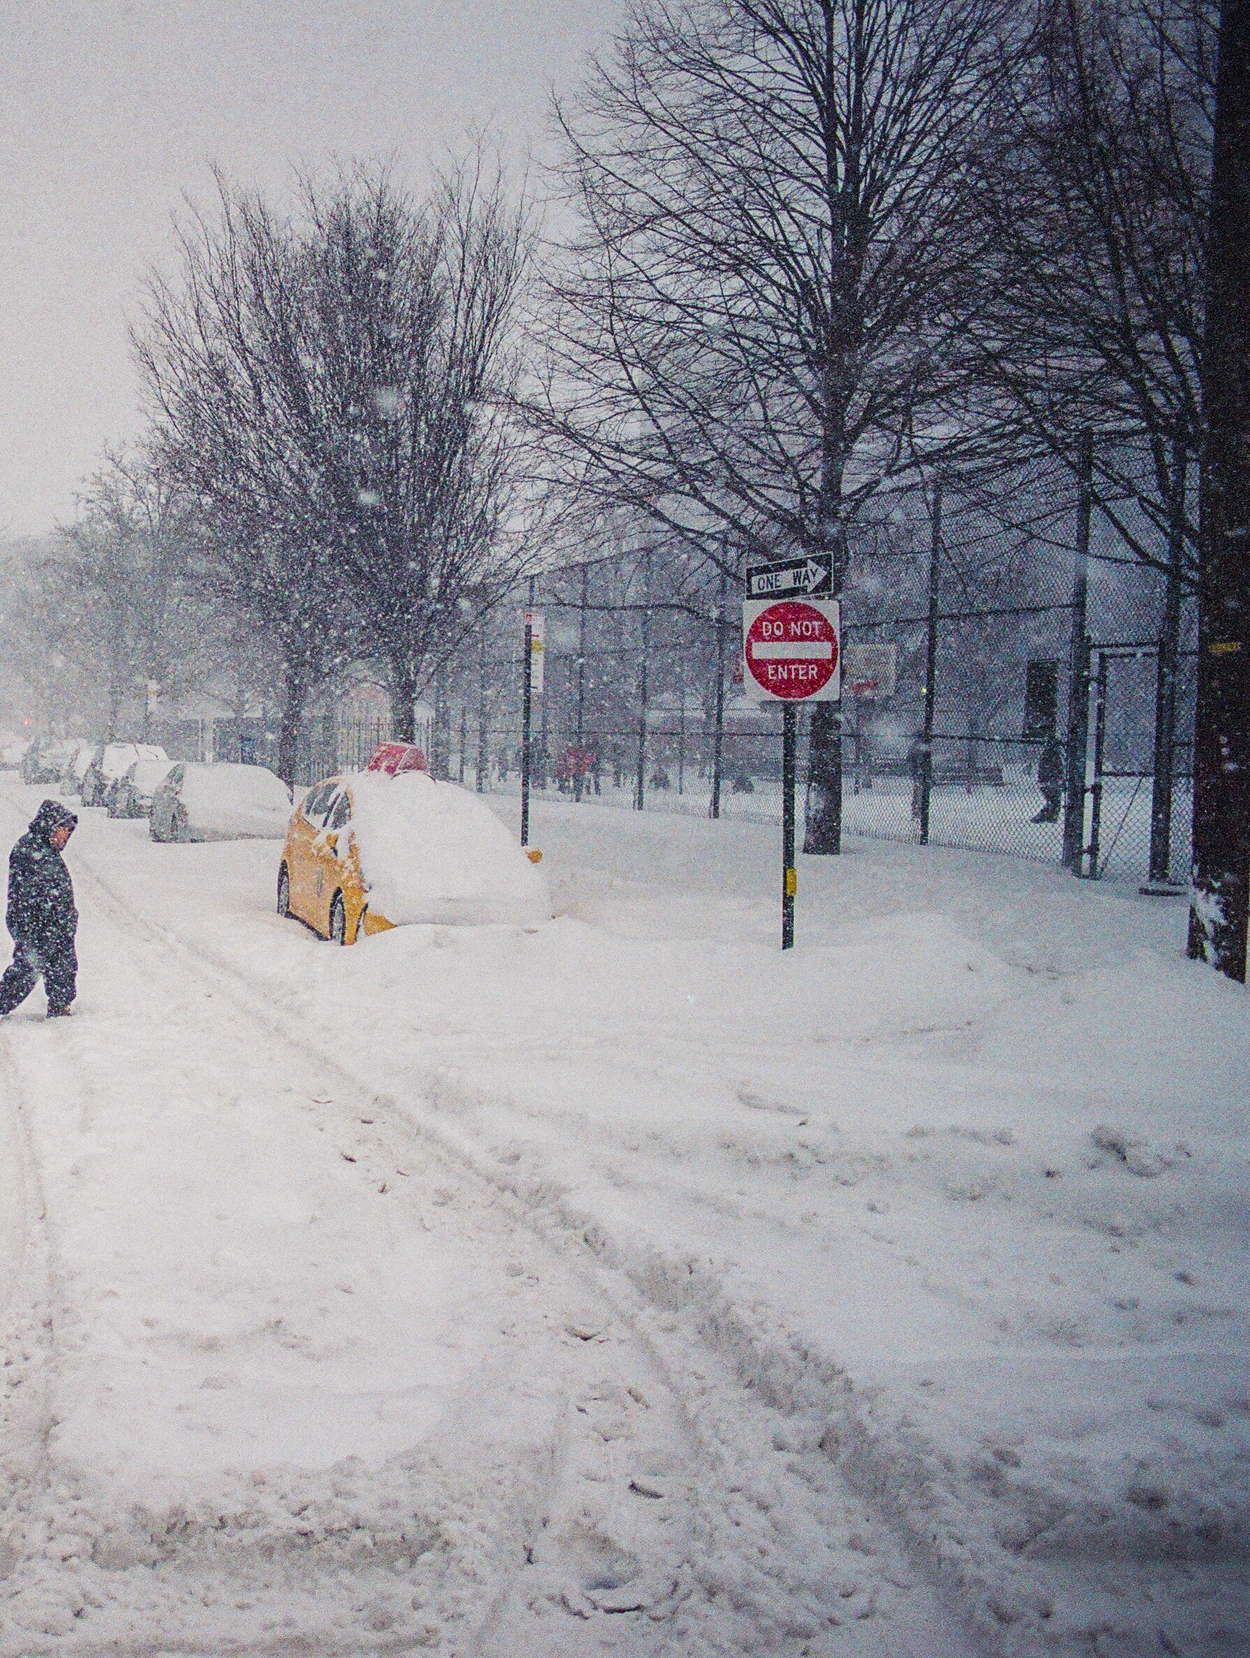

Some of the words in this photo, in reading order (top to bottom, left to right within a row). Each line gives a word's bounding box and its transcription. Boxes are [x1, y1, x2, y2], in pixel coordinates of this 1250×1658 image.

[757, 573, 781, 591] ONE
[792, 567, 818, 586] WAY
[762, 621, 783, 636] DO
[791, 621, 822, 636] NOT
[768, 664, 818, 680] ENTER
